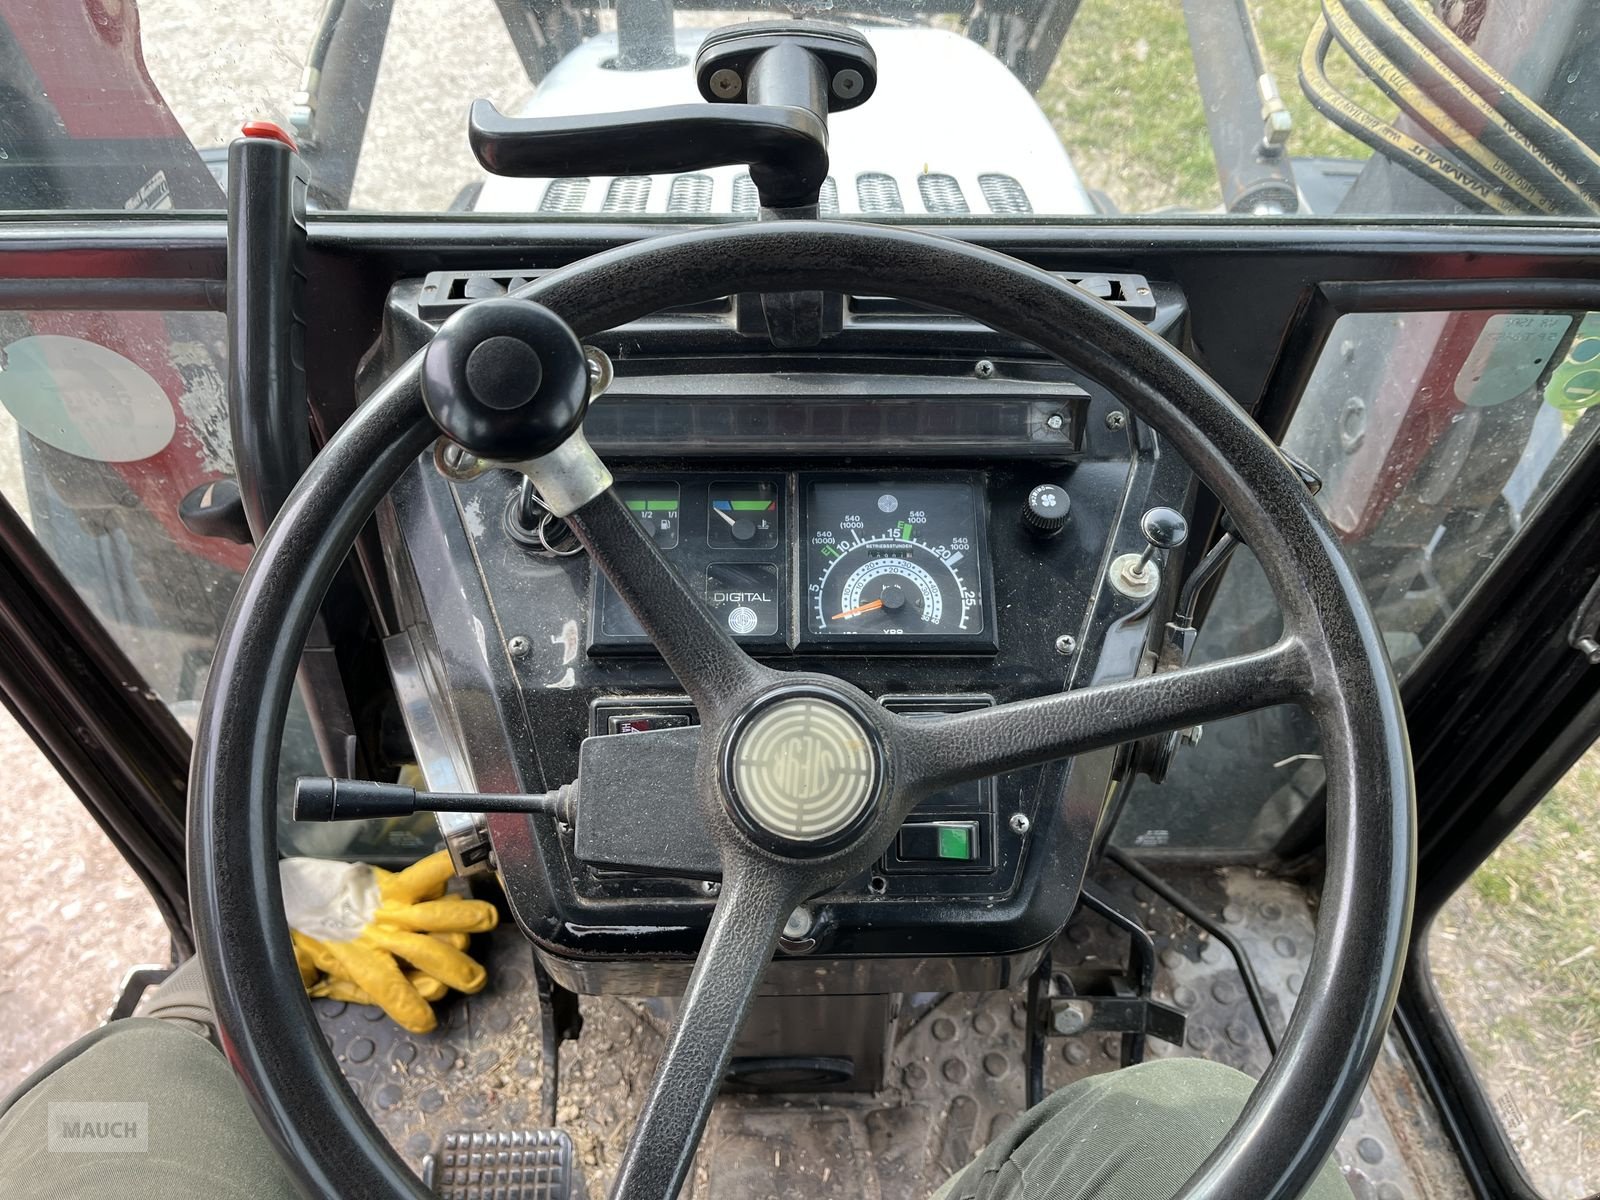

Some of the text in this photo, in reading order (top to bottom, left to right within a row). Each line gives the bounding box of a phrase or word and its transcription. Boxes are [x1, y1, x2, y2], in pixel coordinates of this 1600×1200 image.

[1408, 145, 1490, 198] MAMMUT
[641, 511, 653, 519] 1/2
[897, 520, 905, 529] E
[887, 528, 901, 538] 15
[836, 540, 850, 552] 10
[935, 545, 952, 560] 20
[864, 562, 875, 571] 20
[901, 560, 912, 569] 30
[809, 584, 820, 592] 5
[856, 582, 864, 590] 10
[844, 588, 851, 596] 10
[714, 592, 771, 602] DIGITAL
[964, 591, 976, 606] 25
[773, 735, 835, 798] STEYR
